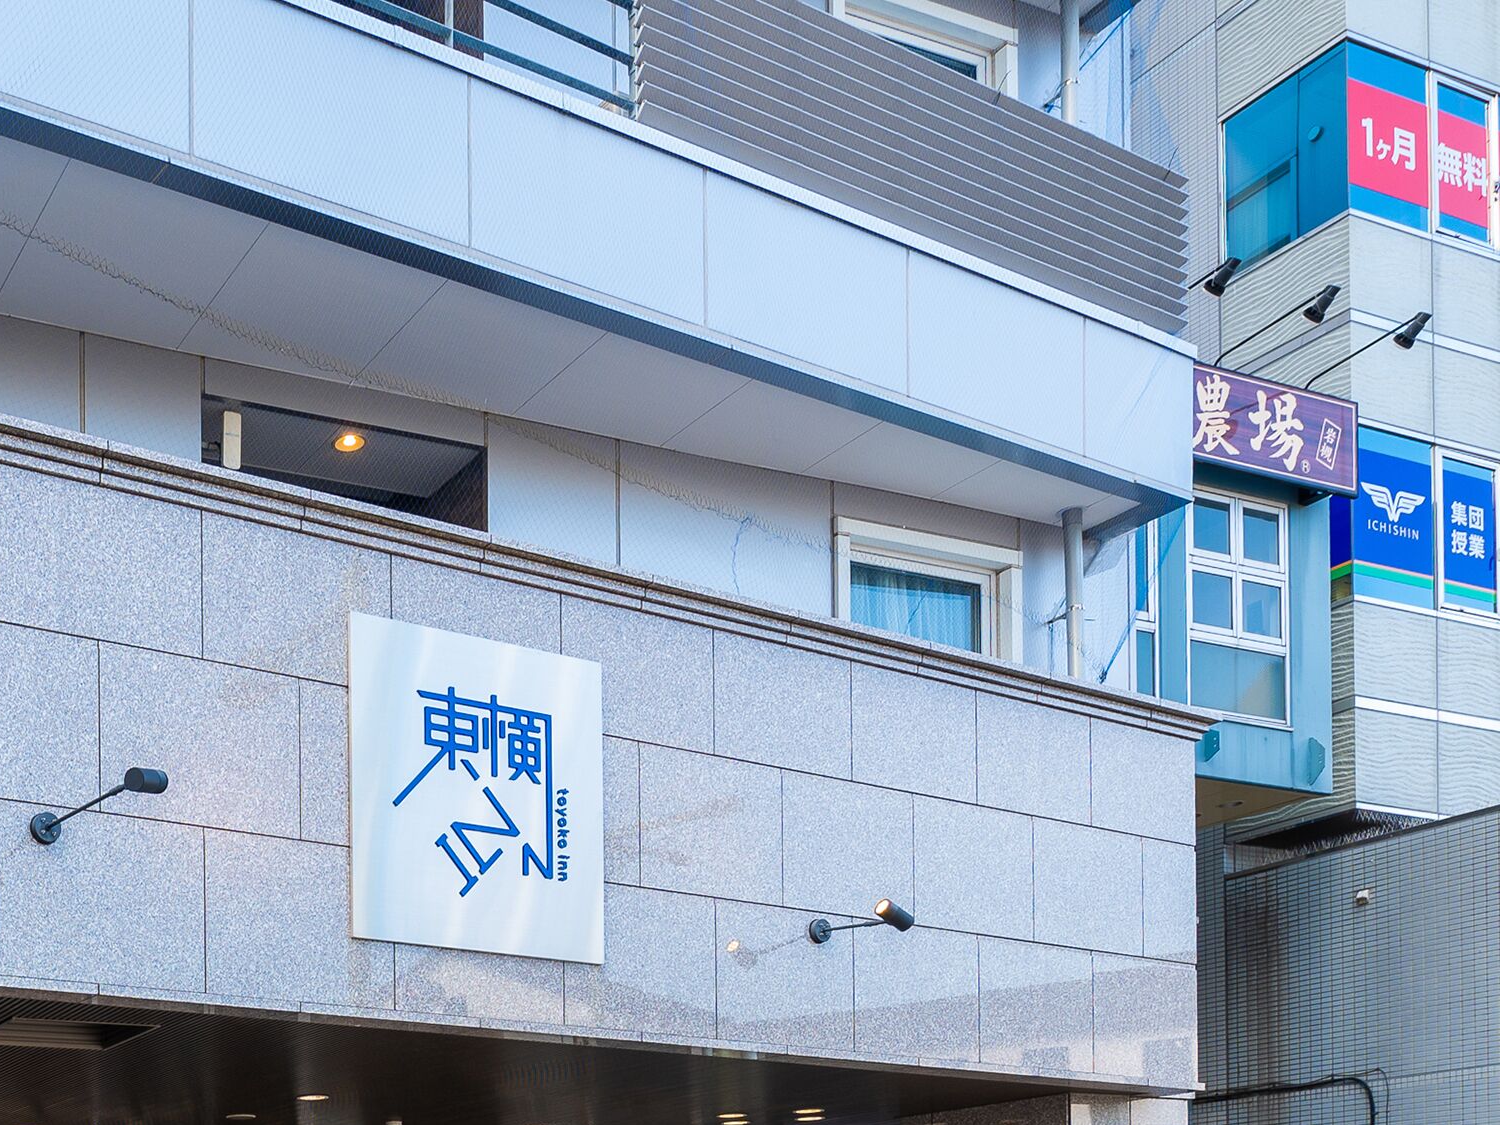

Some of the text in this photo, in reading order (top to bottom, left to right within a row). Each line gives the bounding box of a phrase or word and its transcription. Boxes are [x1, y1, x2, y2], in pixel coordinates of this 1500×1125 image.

[1361, 117, 1487, 197] 1ヶ月 無料
[1193, 374, 1304, 472] 農場
[1319, 427, 1337, 464] 岩槻
[1367, 518, 1420, 541] ICHISHIN
[1450, 500, 1485, 532] 集団
[1450, 529, 1485, 560] 授業
[555, 788, 569, 882] toyoko inn
